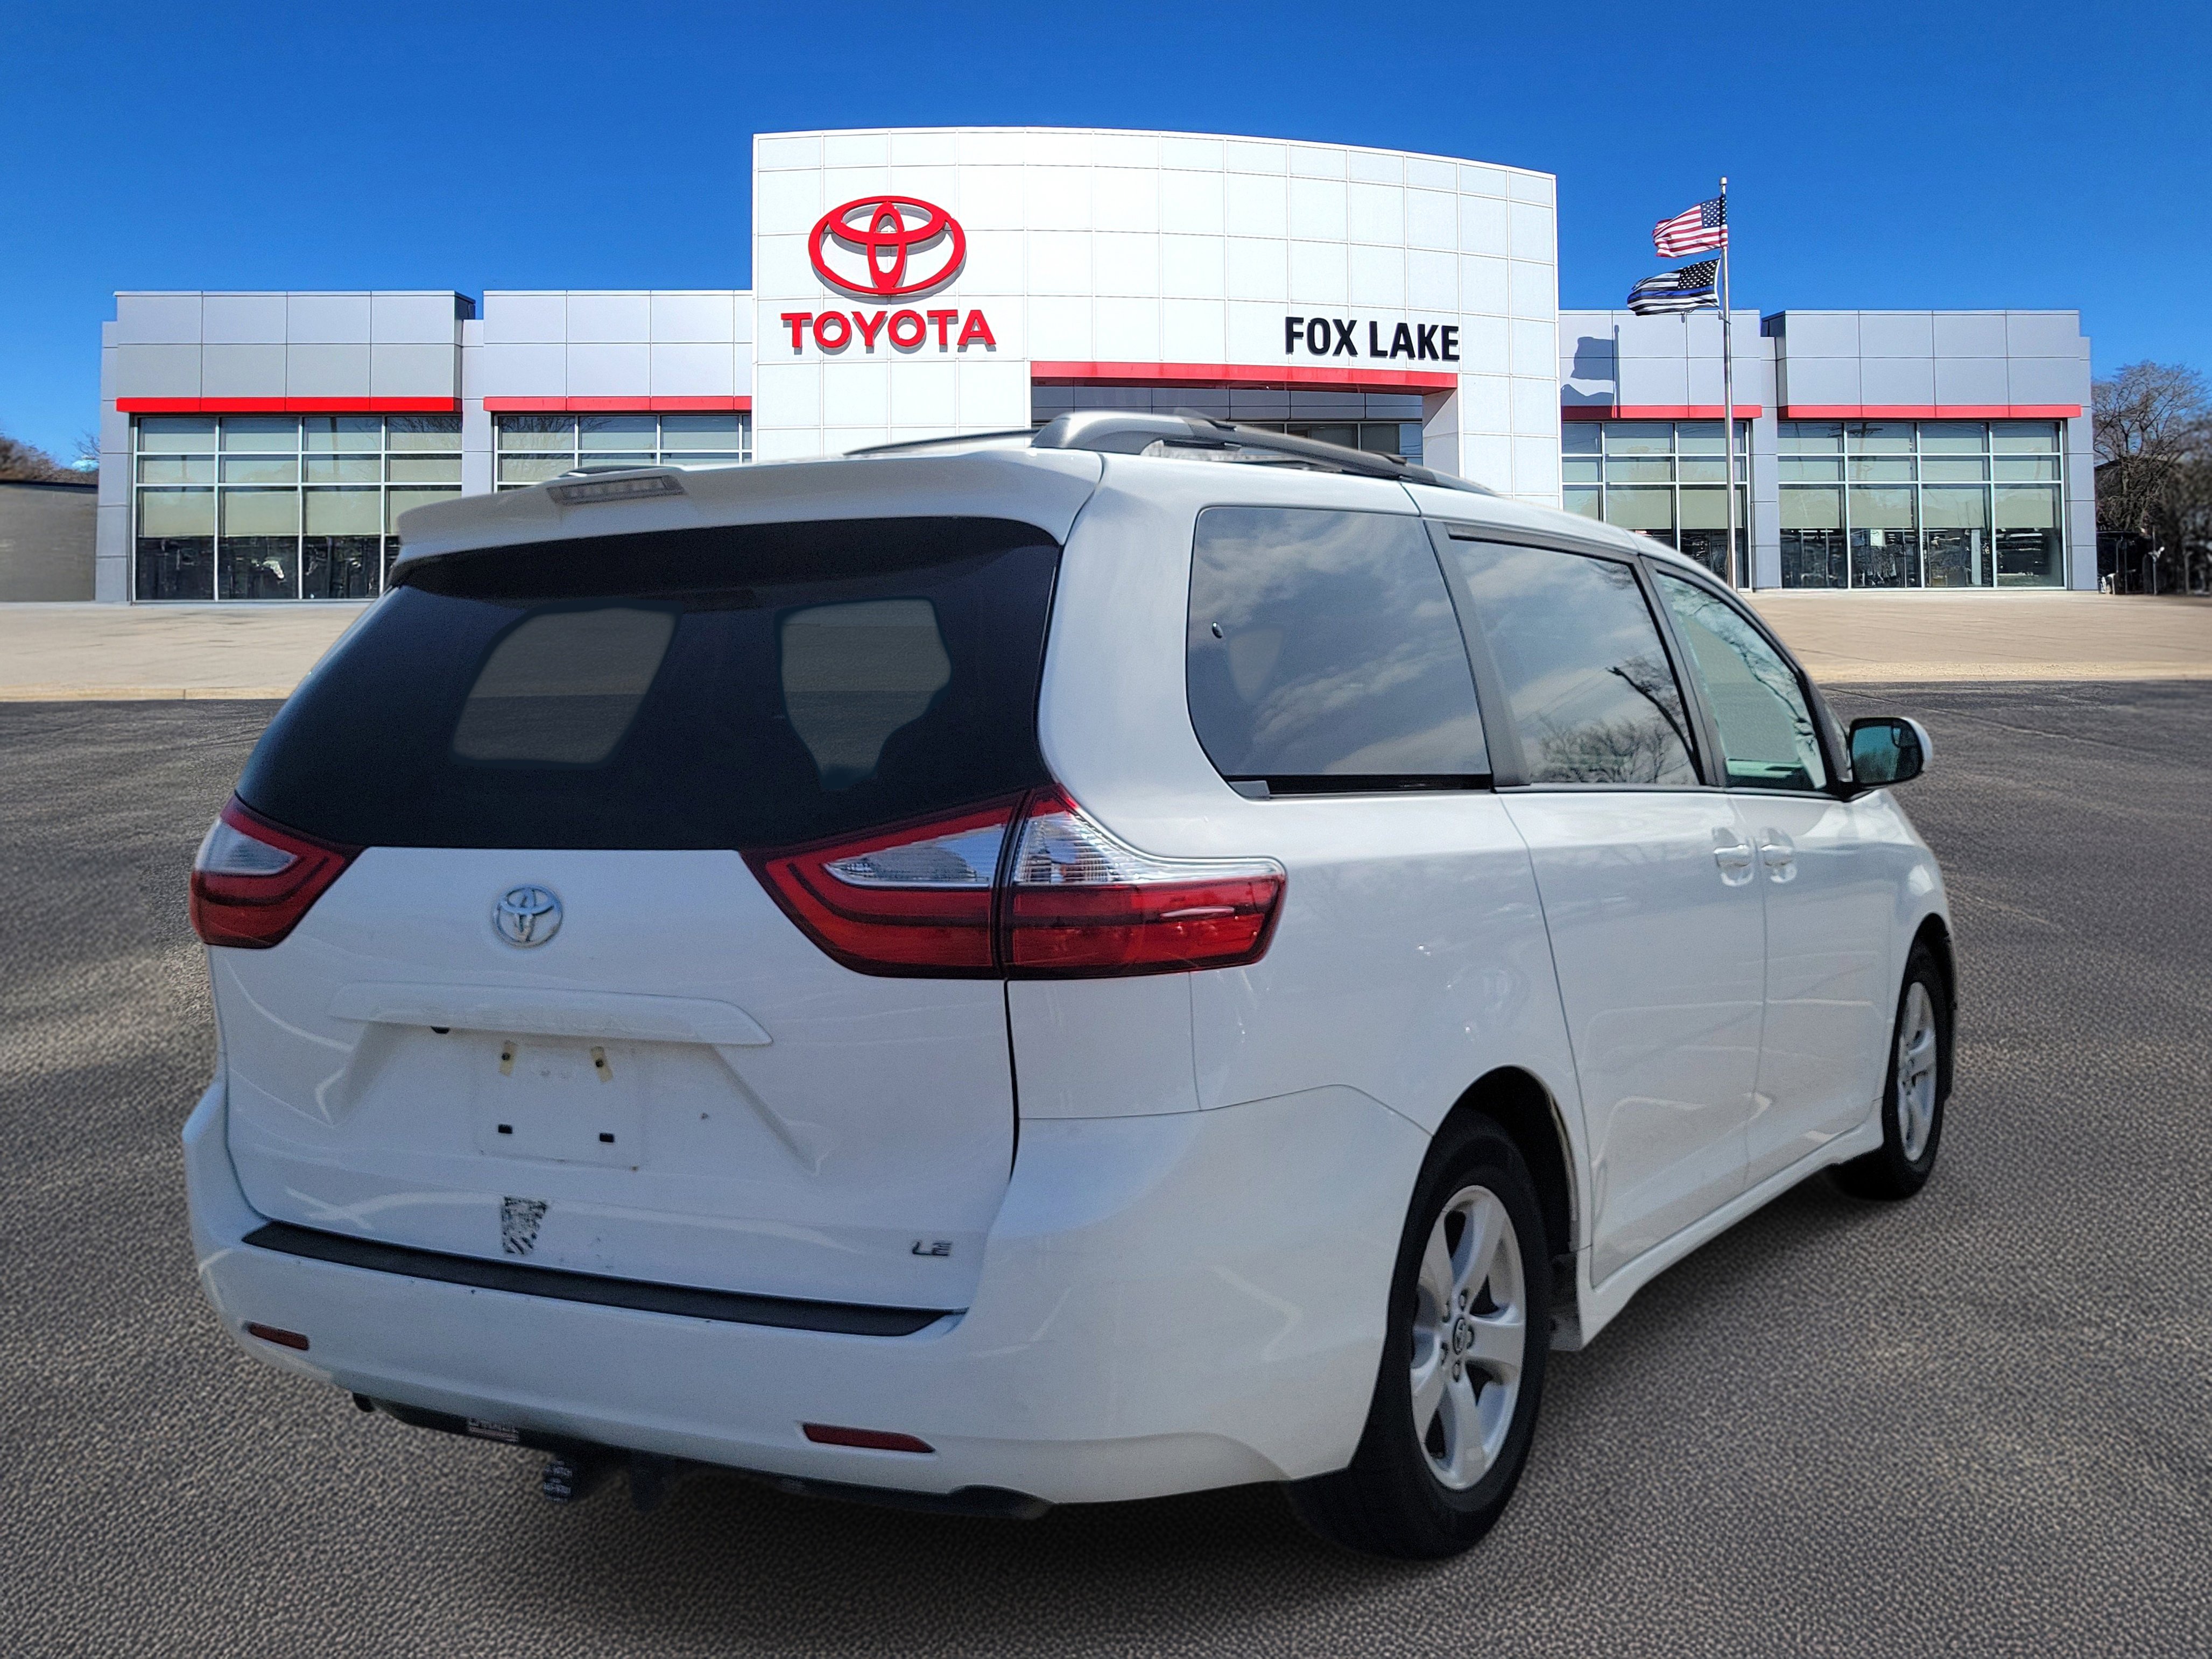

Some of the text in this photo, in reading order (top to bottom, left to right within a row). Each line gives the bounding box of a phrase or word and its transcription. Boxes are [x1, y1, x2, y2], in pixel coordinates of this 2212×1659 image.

[781, 309, 996, 351] TOYOTA
[1285, 316, 1460, 362] FOX LAKE
[912, 1240, 952, 1256] LE
